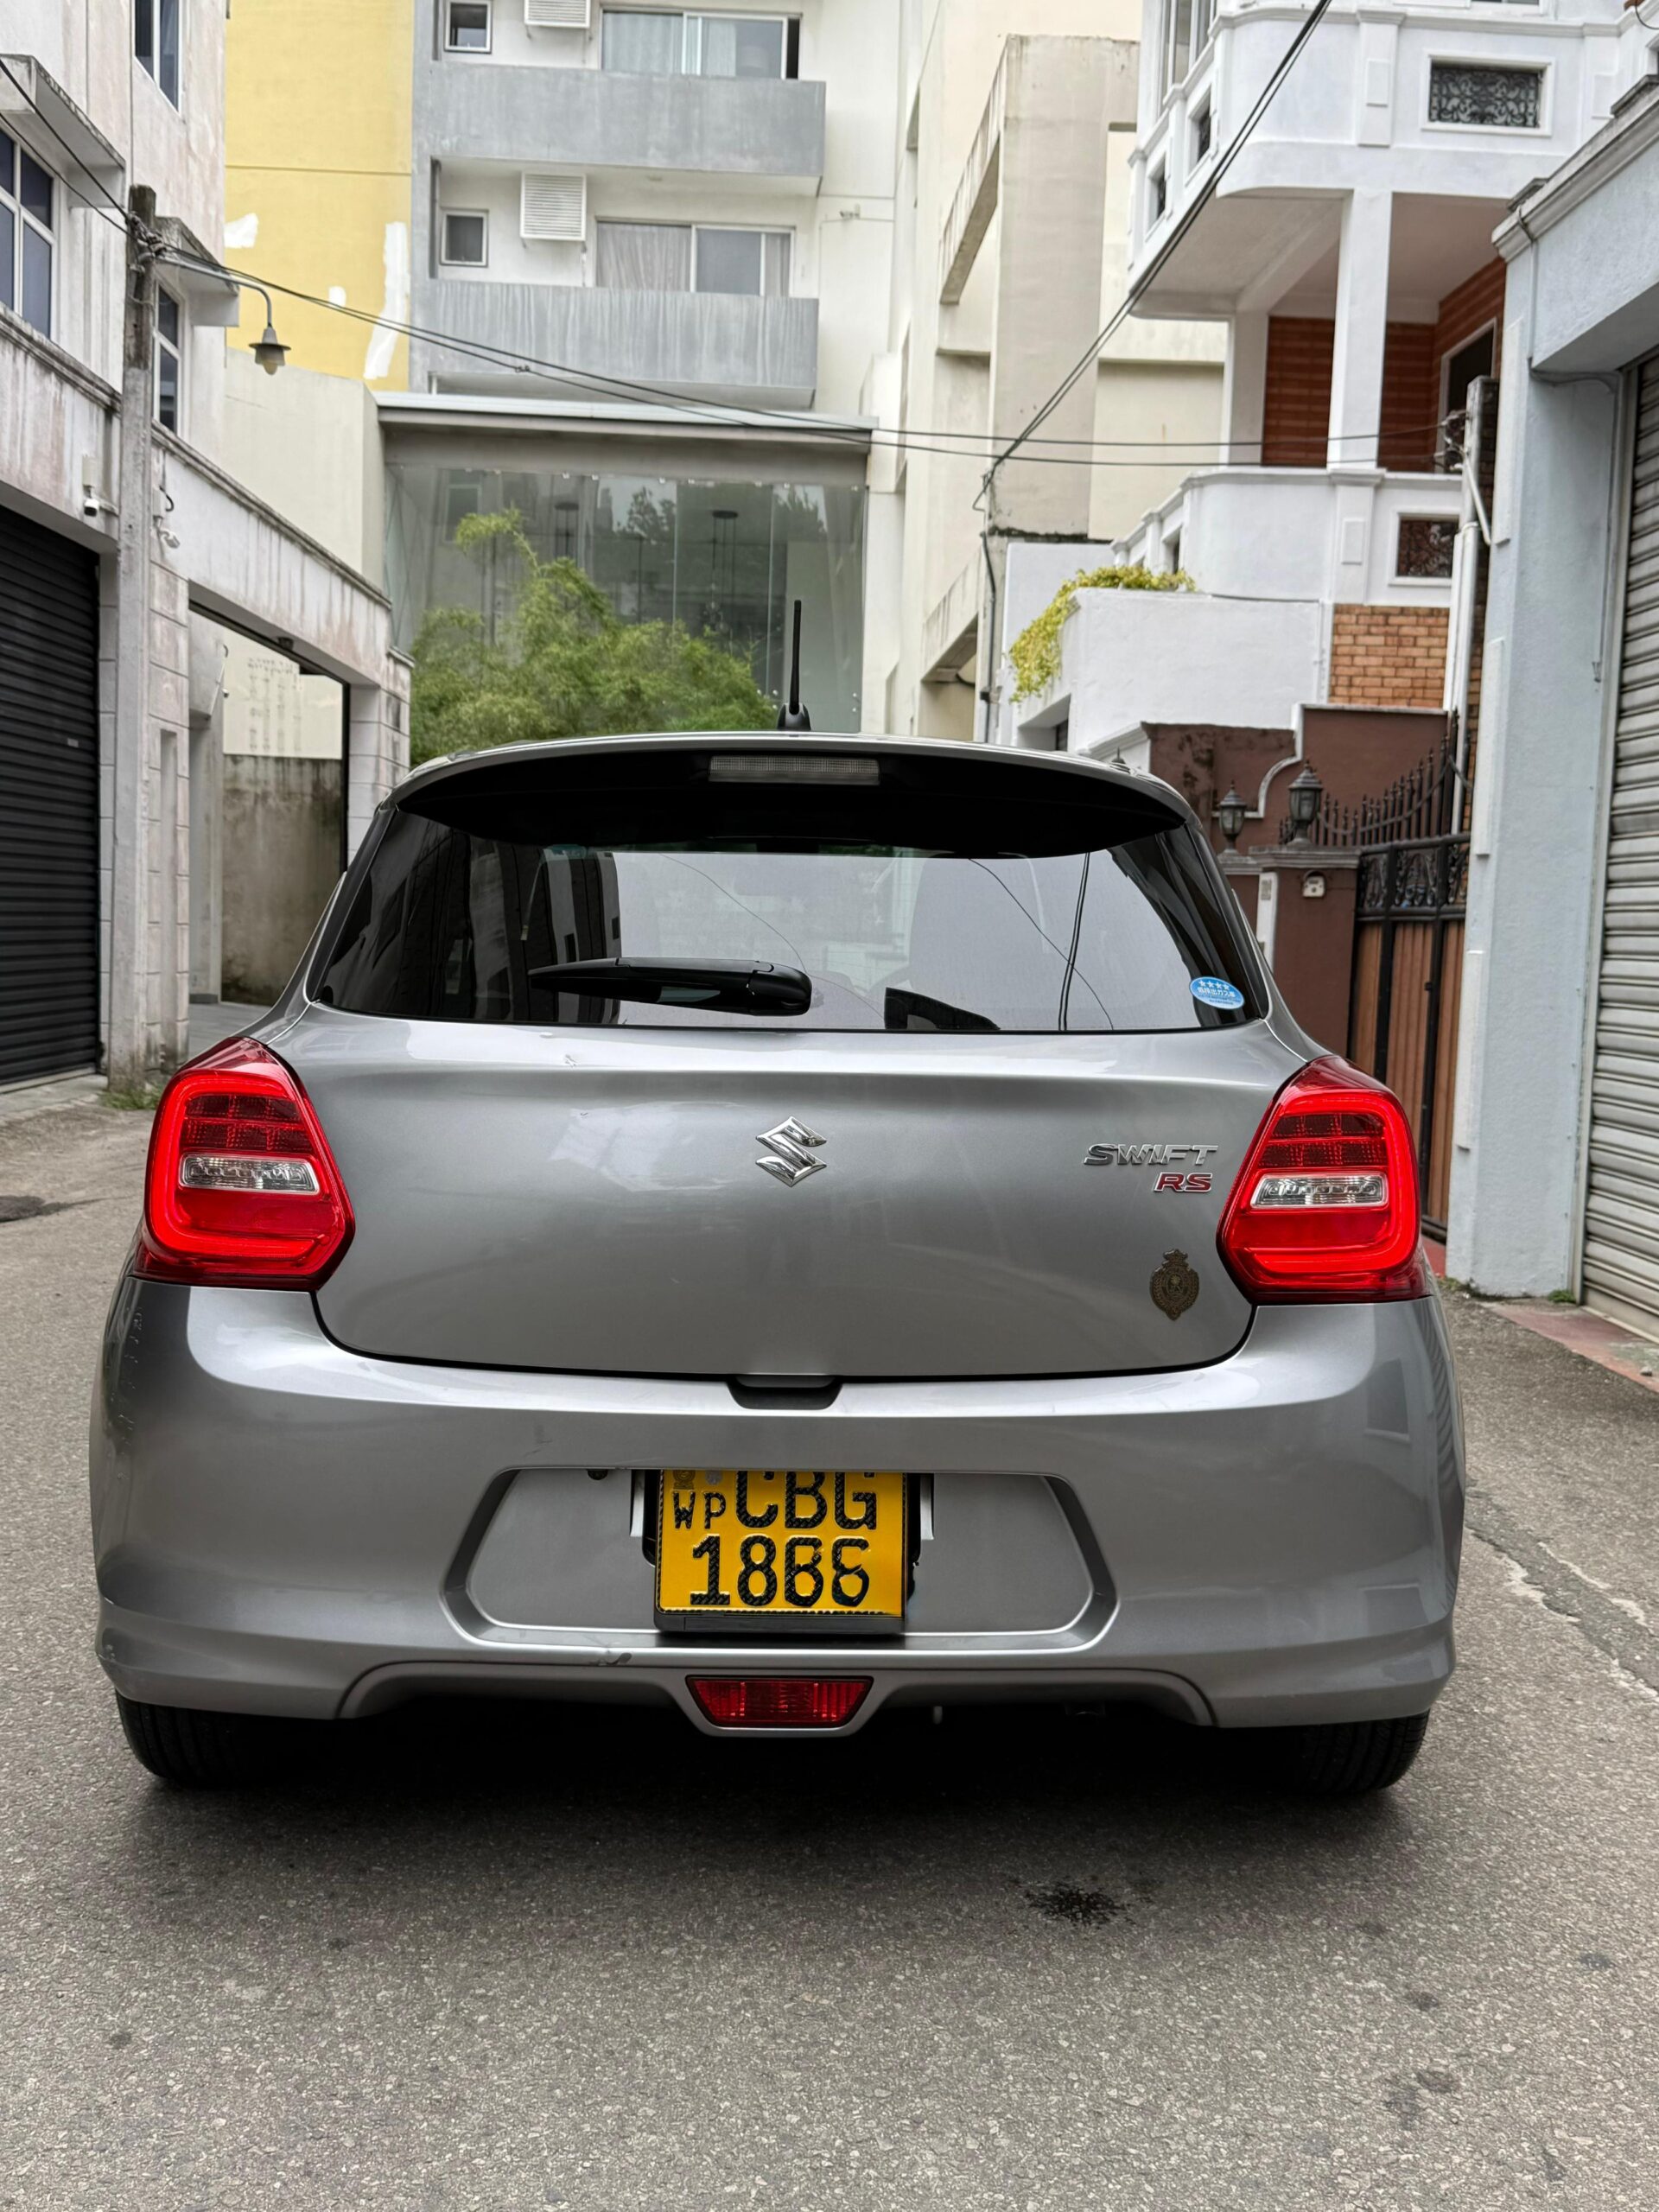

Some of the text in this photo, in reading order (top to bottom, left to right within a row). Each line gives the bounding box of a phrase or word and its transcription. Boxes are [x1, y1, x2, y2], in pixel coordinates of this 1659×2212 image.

[1084, 1143, 1218, 1166] SWIFT
[1153, 1172, 1213, 1192] RS
[673, 1470, 877, 1529] WP CBG
